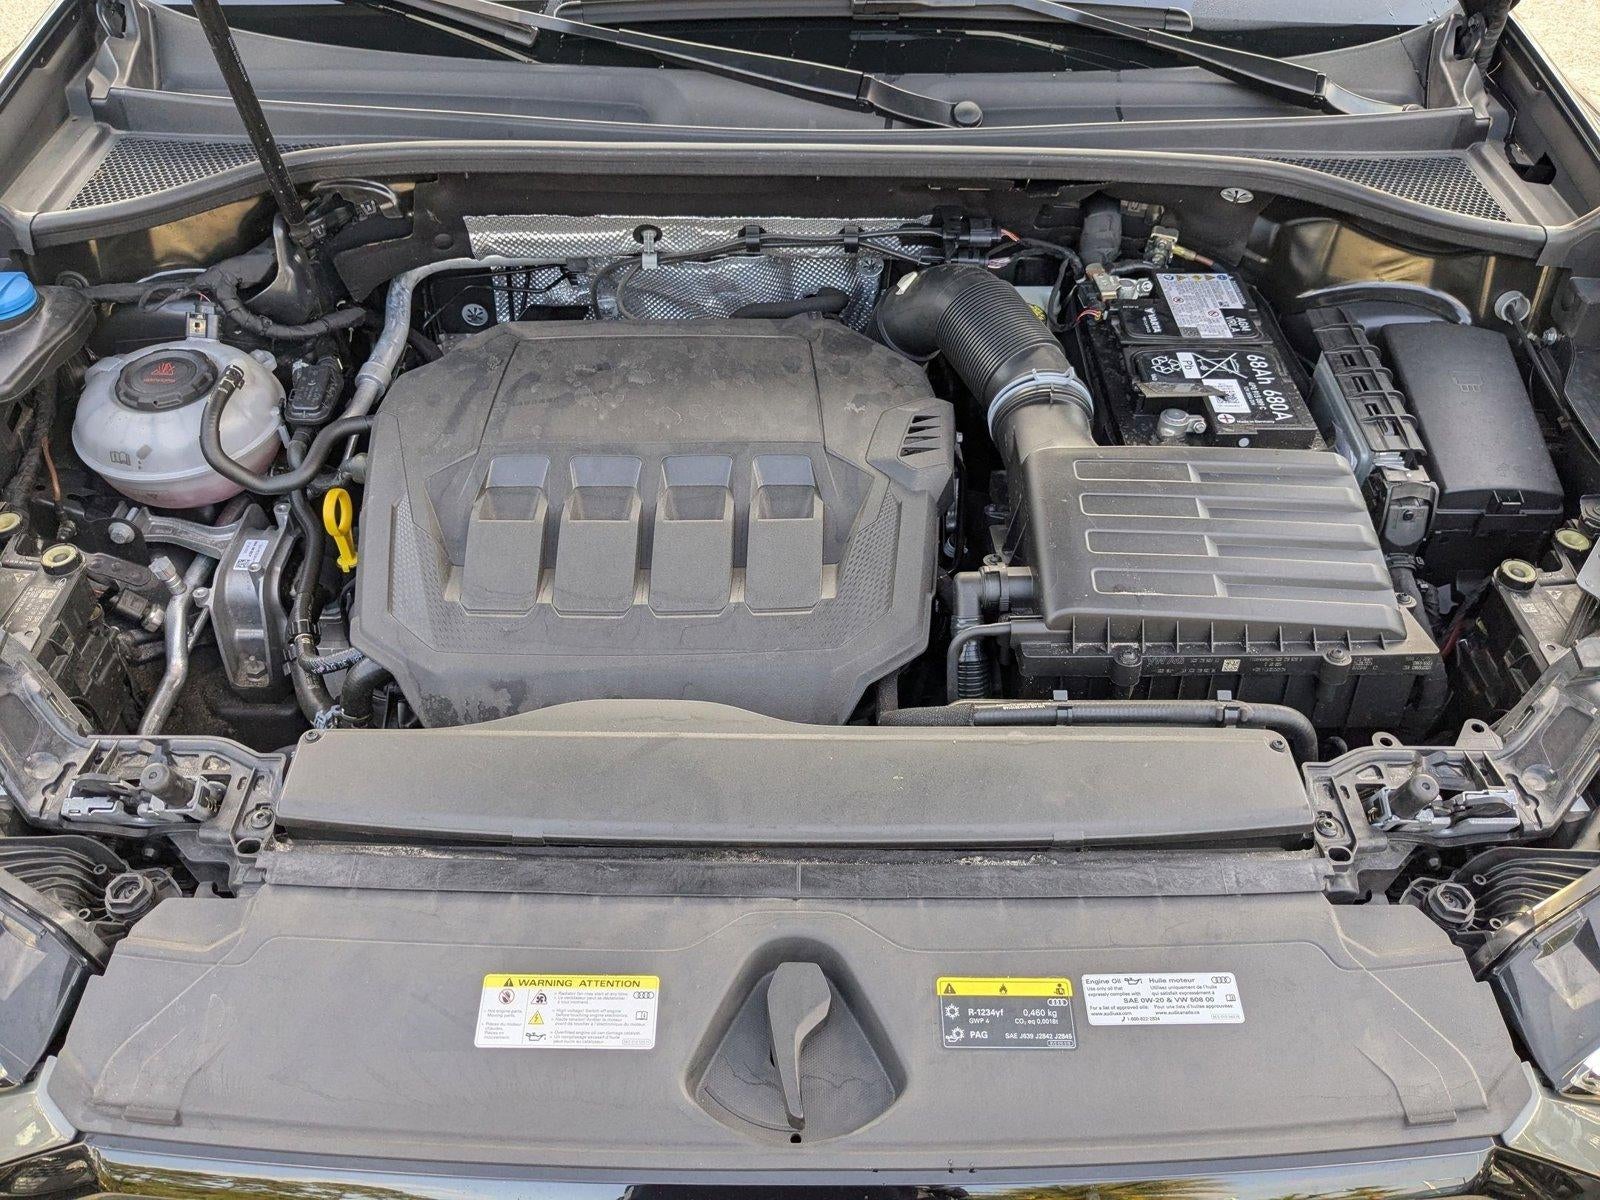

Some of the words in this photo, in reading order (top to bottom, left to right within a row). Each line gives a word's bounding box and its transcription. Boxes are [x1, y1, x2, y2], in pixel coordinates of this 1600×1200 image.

[1246, 354, 1276, 384] 68Ah
[1262, 389, 1294, 420] 680A
[518, 979, 572, 987] WARNING
[578, 980, 640, 988] ATTENTION
[968, 1008, 1004, 1018] R-1234yf
[1048, 1009, 1057, 1018] kg
